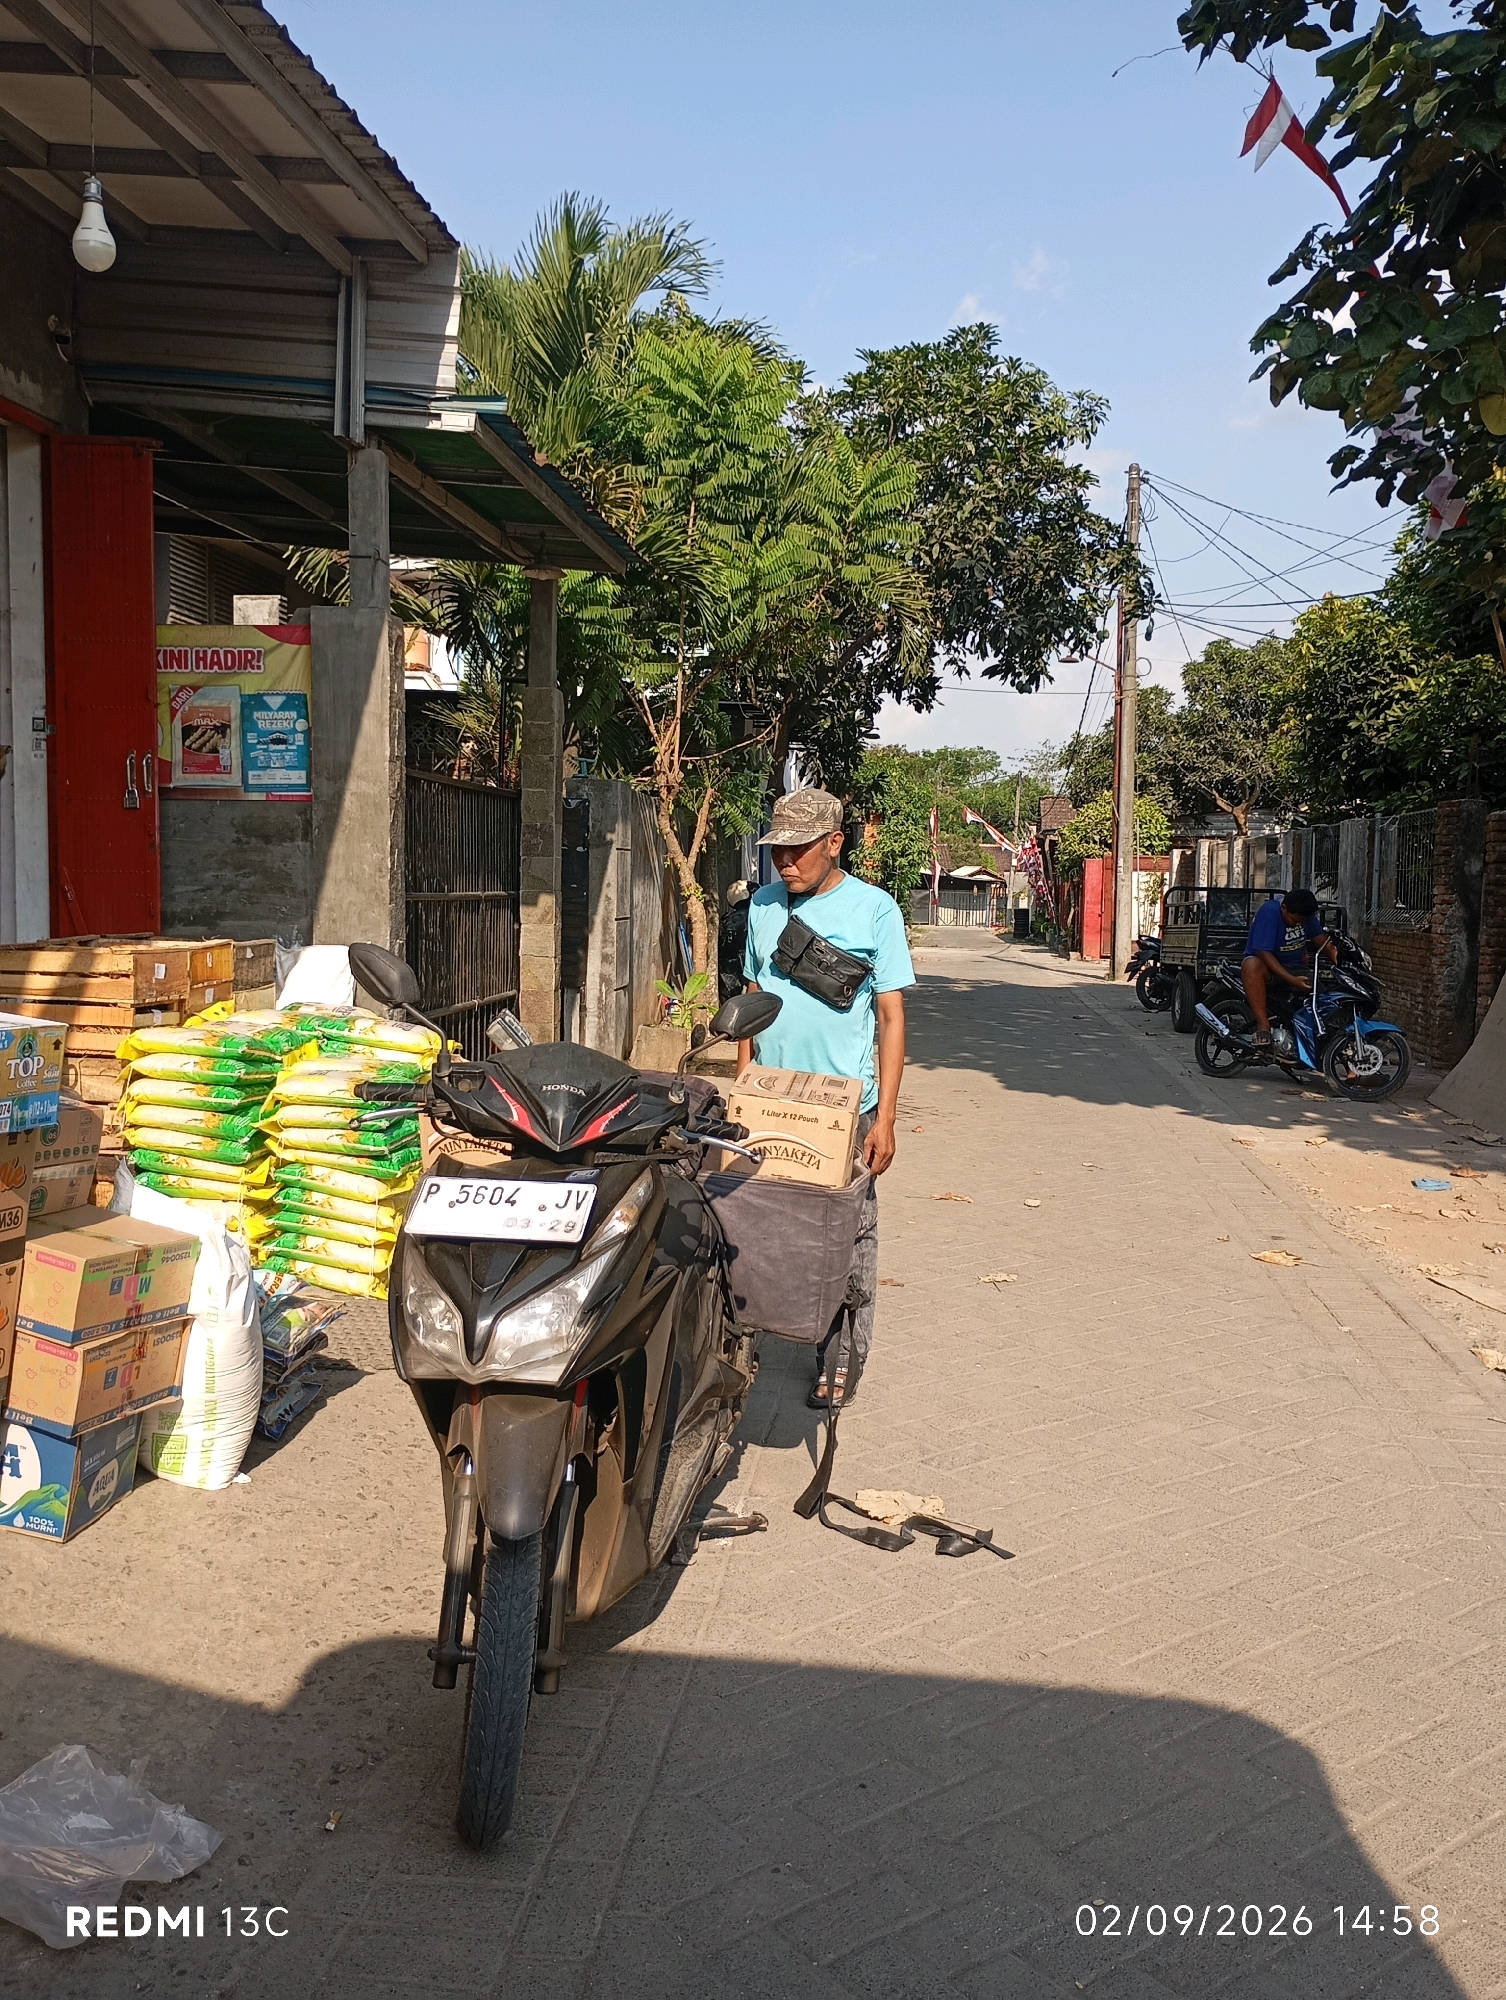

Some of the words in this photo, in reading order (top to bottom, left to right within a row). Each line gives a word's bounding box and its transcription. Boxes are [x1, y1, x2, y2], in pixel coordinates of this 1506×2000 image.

[194, 648, 263, 672] HADIR!
[171, 686, 194, 710] BARU
[253, 710, 297, 720] MILYARAN
[258, 719, 294, 729] REZEKI
[6, 1055, 45, 1079] TOP
[16, 1078, 38, 1089] Coffee
[541, 1083, 587, 1097] HONDA
[761, 1108, 766, 1116] 1
[766, 1109, 781, 1118] Liter
[798, 1115, 819, 1124] Pouch
[423, 1182, 441, 1204] P
[455, 1184, 522, 1207] 5604
[555, 1189, 590, 1212] JV
[160, 1251, 191, 1264] 1250046
[163, 1307, 180, 1317] Beli
[204, 1337, 216, 1394] MULTIGUNA
[92, 1467, 117, 1497] AQUA
[28, 1515, 54, 1527] 100%
